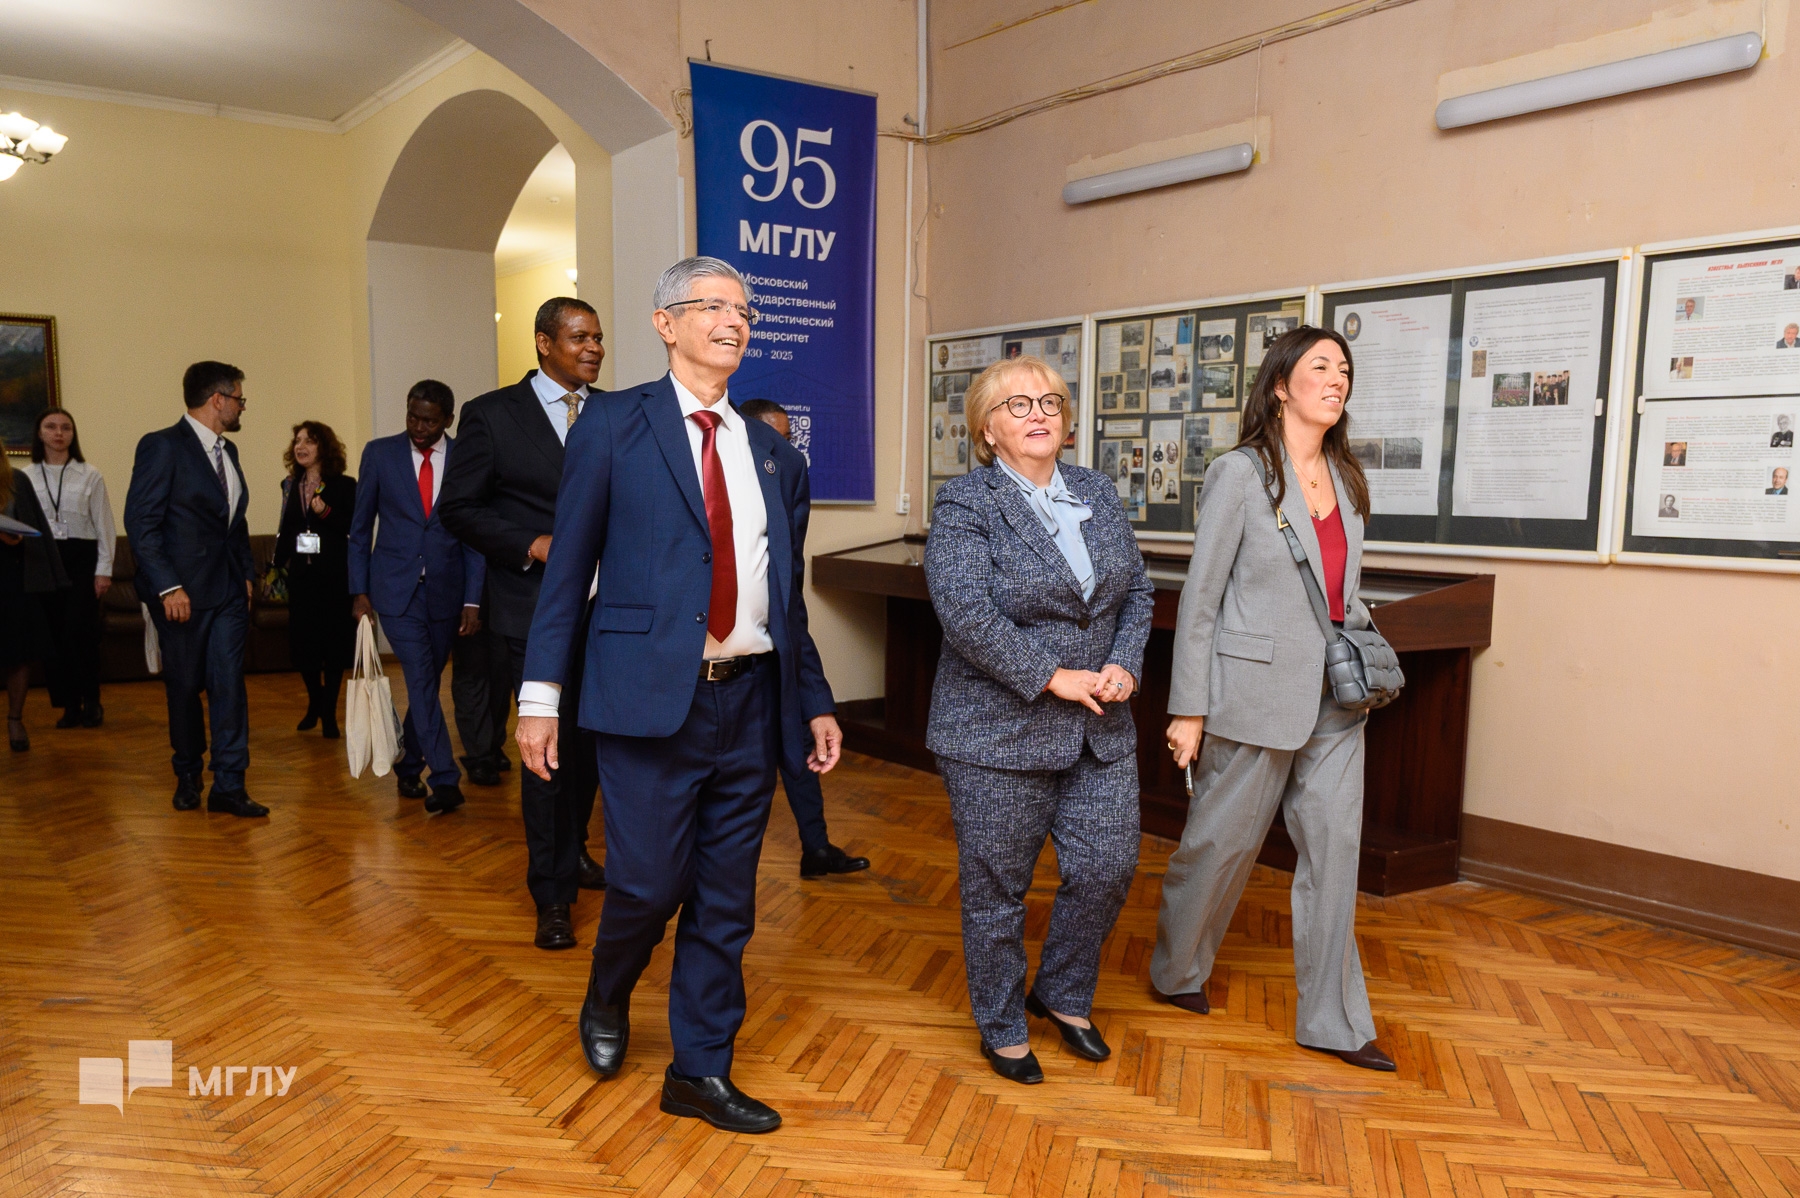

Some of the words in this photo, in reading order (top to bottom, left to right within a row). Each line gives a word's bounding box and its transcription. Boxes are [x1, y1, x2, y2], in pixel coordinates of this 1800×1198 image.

[739, 118, 837, 210] 95
[739, 219, 837, 262] МГЛУ
[740, 272, 808, 290] Московский
[752, 294, 836, 311] сударственный
[758, 312, 834, 328] гвистический
[749, 330, 809, 343] ниверситет
[744, 347, 763, 359] 930
[770, 349, 793, 361] 2025
